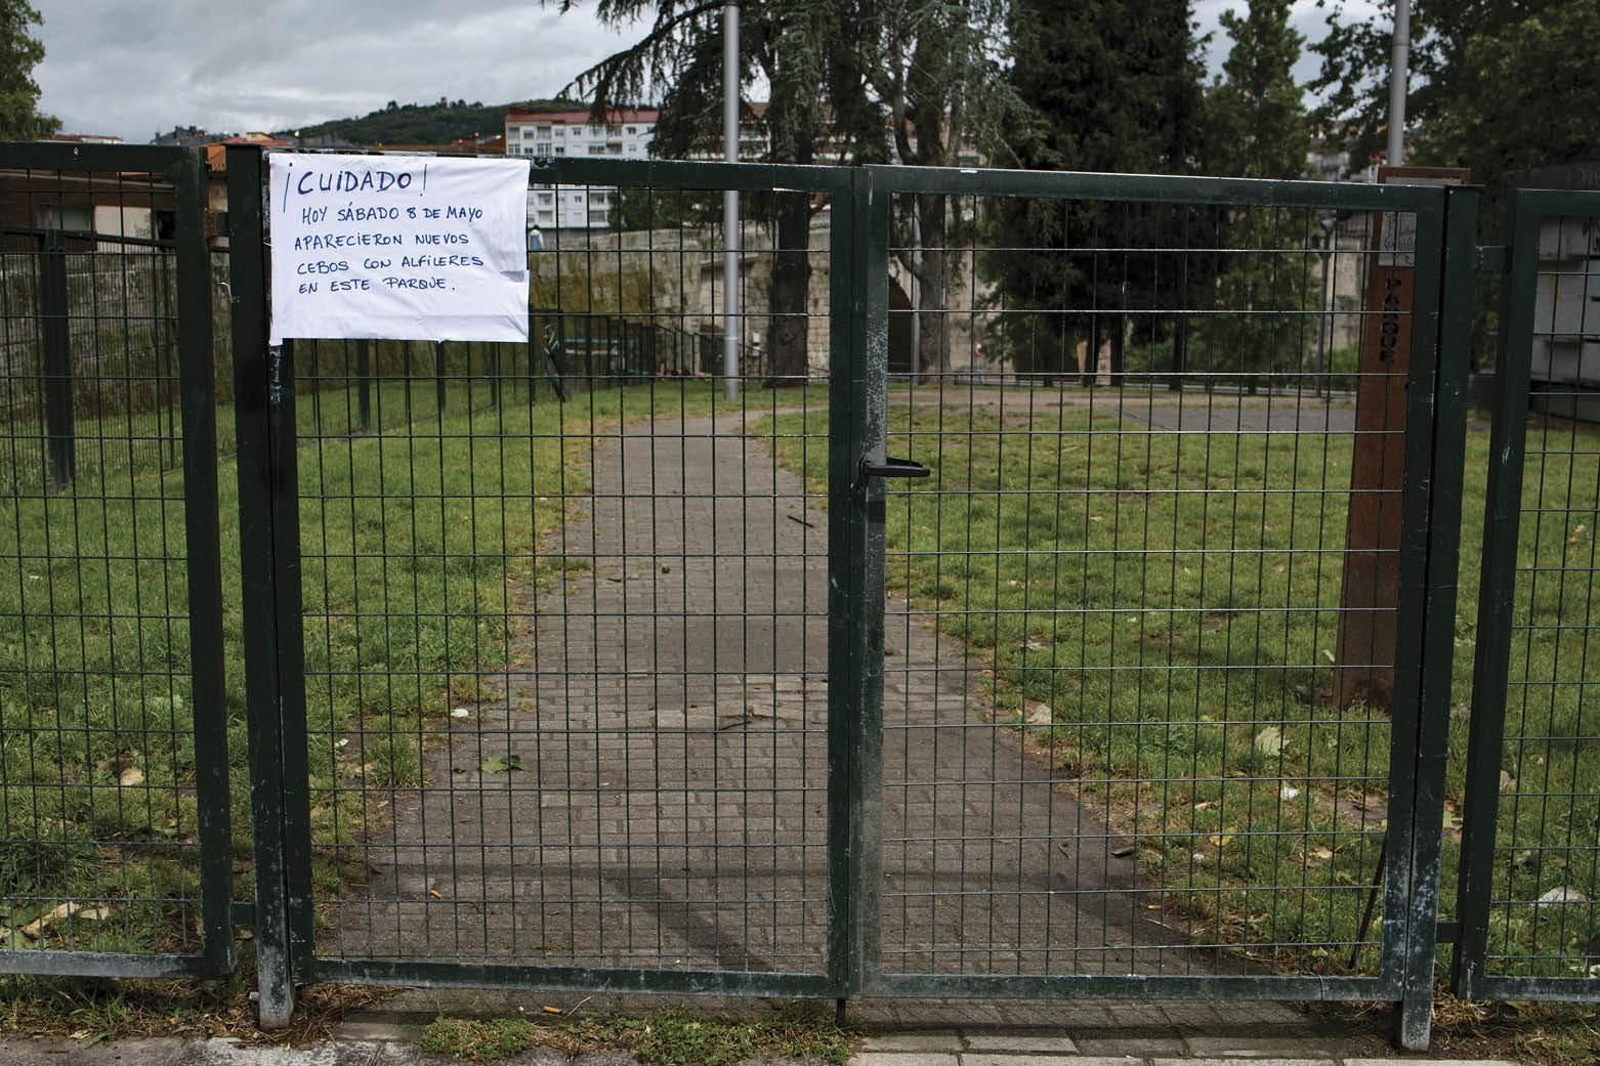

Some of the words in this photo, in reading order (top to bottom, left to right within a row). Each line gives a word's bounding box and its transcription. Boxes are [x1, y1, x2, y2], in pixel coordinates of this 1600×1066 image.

[302, 206, 328, 225] HOY
[337, 202, 399, 222] SÁBADO
[406, 207, 417, 219] 8
[423, 208, 441, 219] DE
[446, 206, 484, 222] MAYO
[295, 232, 402, 251] APARECIERON
[415, 234, 469, 245] NUEVOS
[297, 261, 349, 275] CEBOS
[364, 258, 391, 269] CON
[401, 255, 484, 267] ALFILERES
[299, 282, 318, 294] EN
[330, 278, 370, 292] ESTE
[382, 277, 455, 291] PARQUE.
